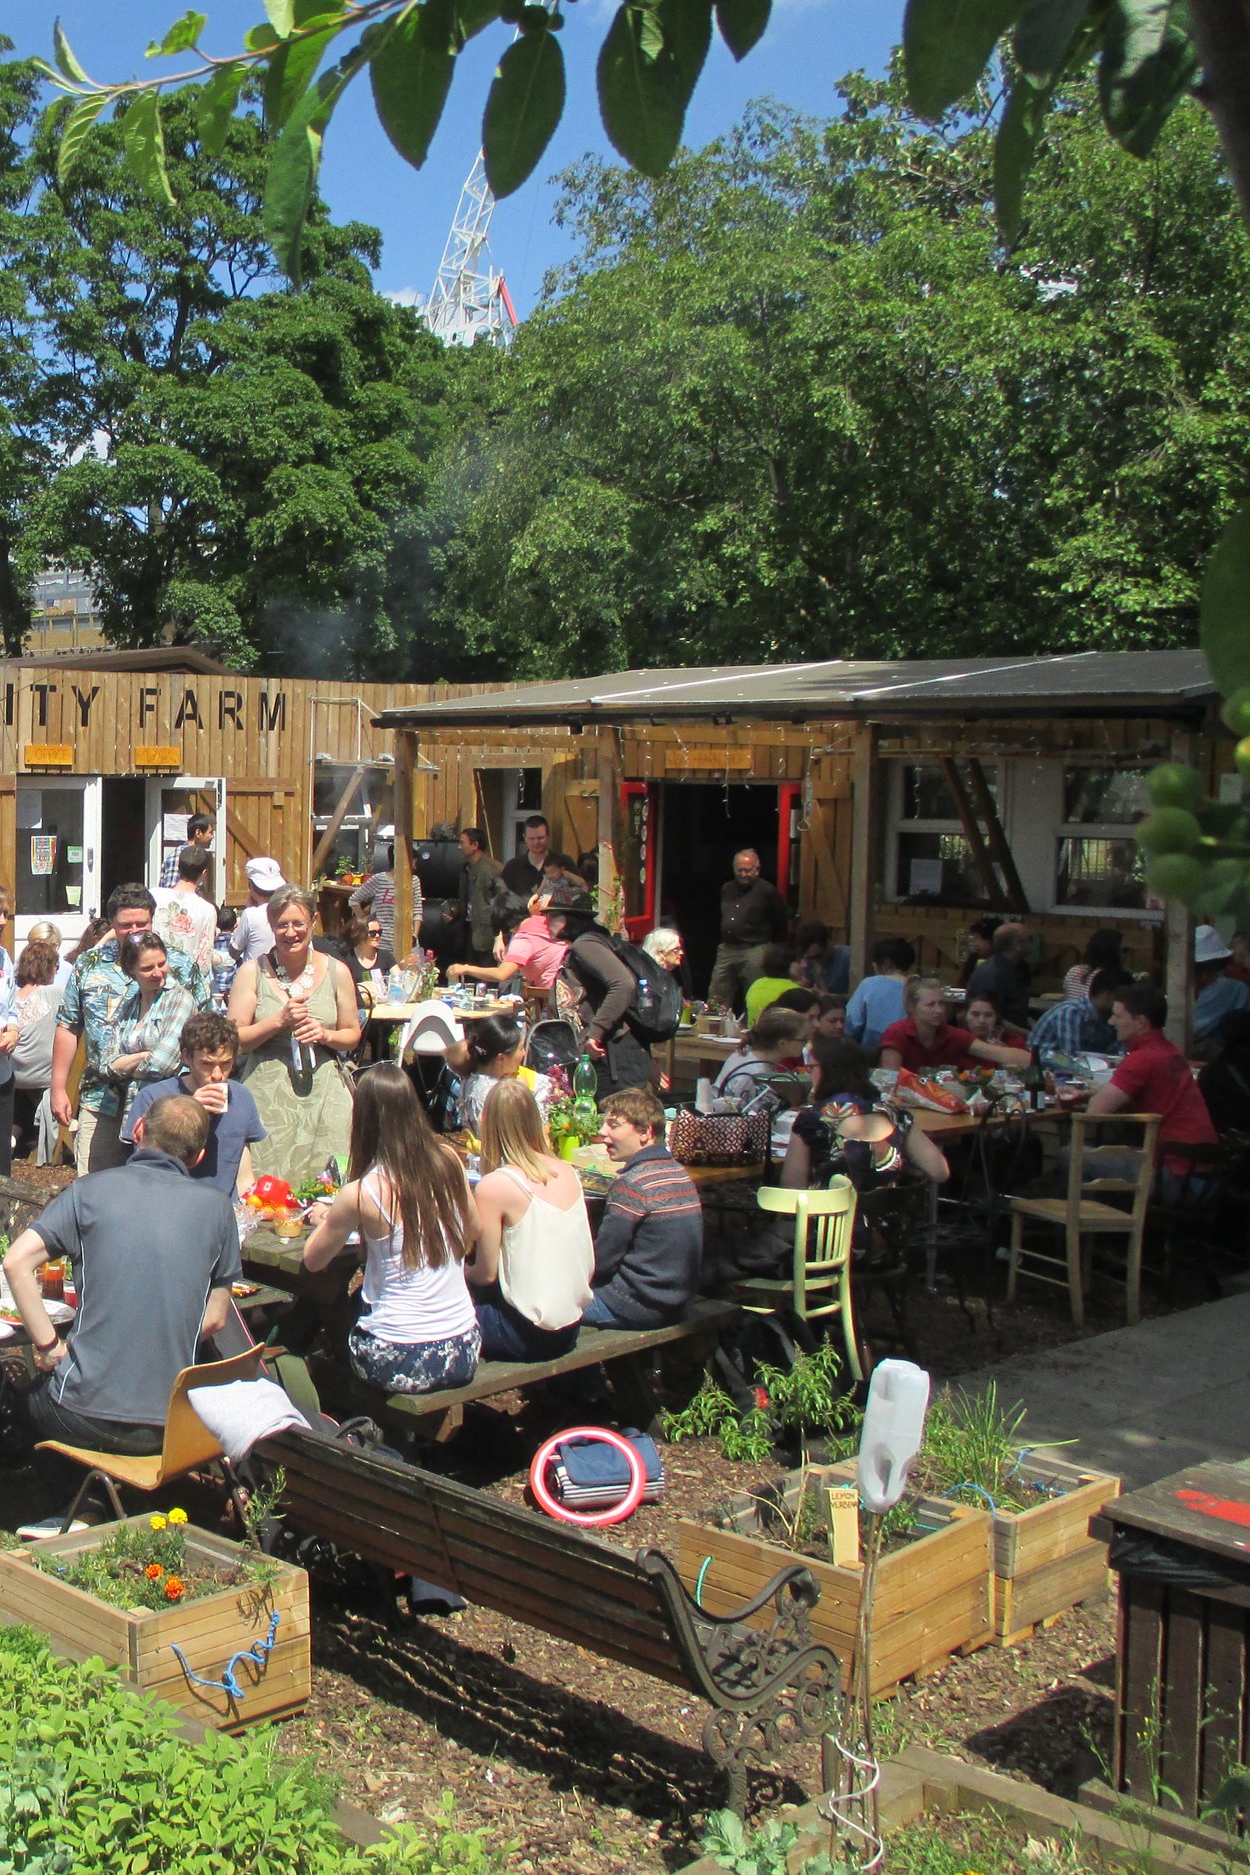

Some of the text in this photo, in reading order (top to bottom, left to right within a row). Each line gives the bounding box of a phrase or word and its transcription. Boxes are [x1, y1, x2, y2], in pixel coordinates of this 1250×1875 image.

[139, 687, 286, 731] FARM
[34, 748, 68, 761] OFFICE
[831, 1492, 856, 1500] LEMON
